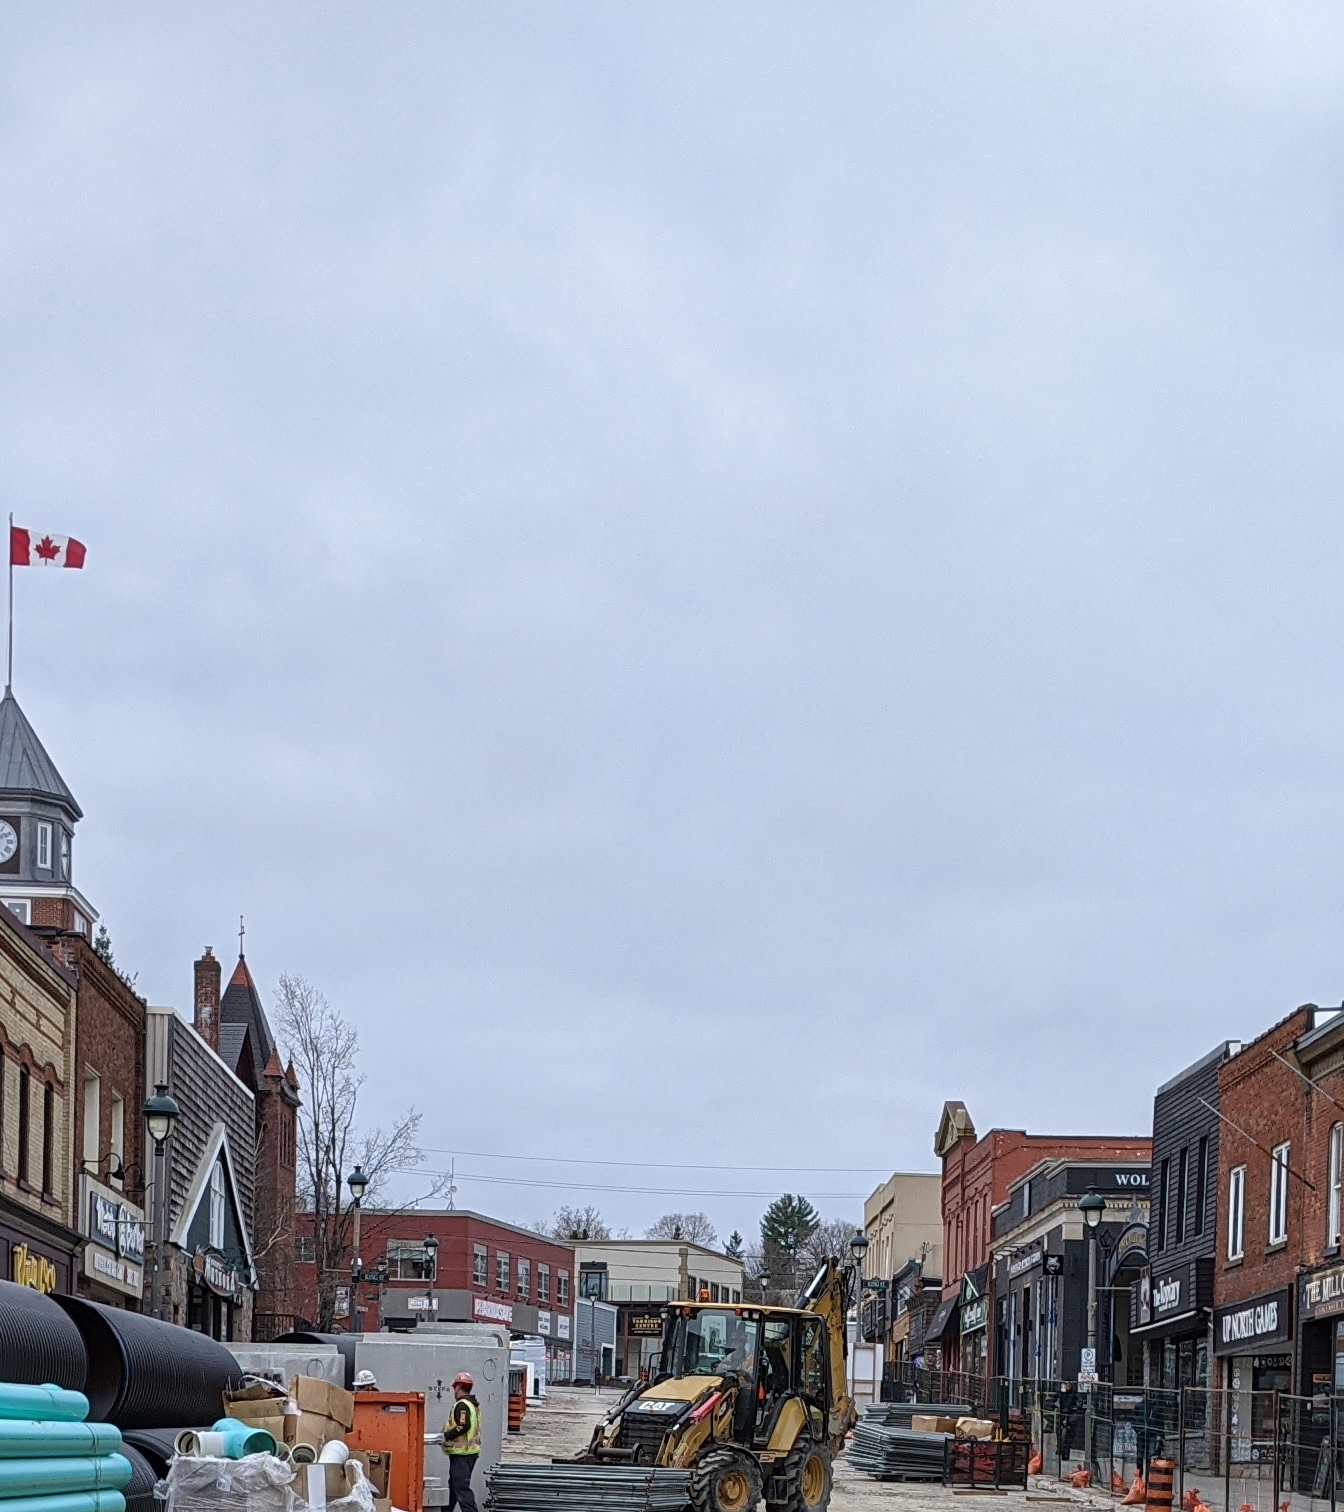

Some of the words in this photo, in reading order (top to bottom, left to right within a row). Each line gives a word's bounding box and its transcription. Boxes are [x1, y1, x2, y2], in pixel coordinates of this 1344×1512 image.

[1305, 1281, 1321, 1309] THE
[1322, 1276, 1341, 1303] MILL
[1222, 1315, 1231, 1343] UP
[1231, 1308, 1254, 1341] NORTH
[1255, 1301, 1277, 1335] GAMES
[638, 1401, 675, 1411] CAT
